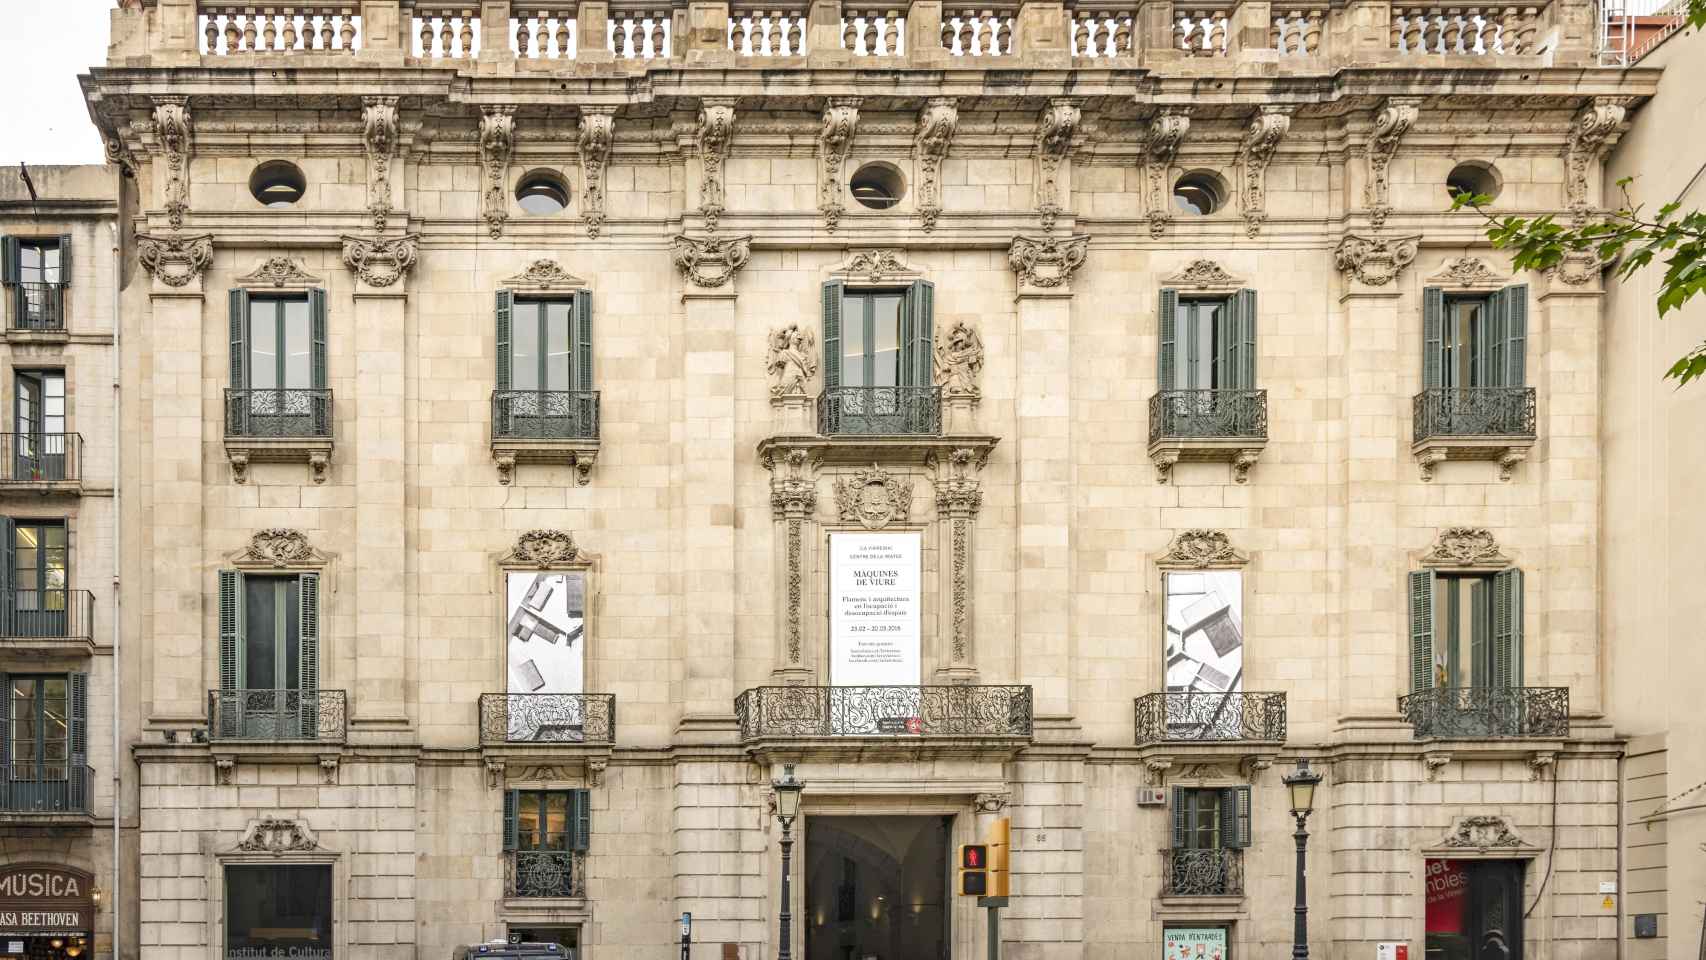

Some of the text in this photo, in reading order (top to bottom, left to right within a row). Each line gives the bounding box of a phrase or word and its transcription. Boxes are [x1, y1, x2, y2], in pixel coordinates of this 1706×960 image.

[856, 578, 897, 586] DE VIURE
[0, 912, 79, 926] ASA BEETHOVEN
[1167, 933, 1186, 941] VENDA
[271, 946, 286, 958] de
